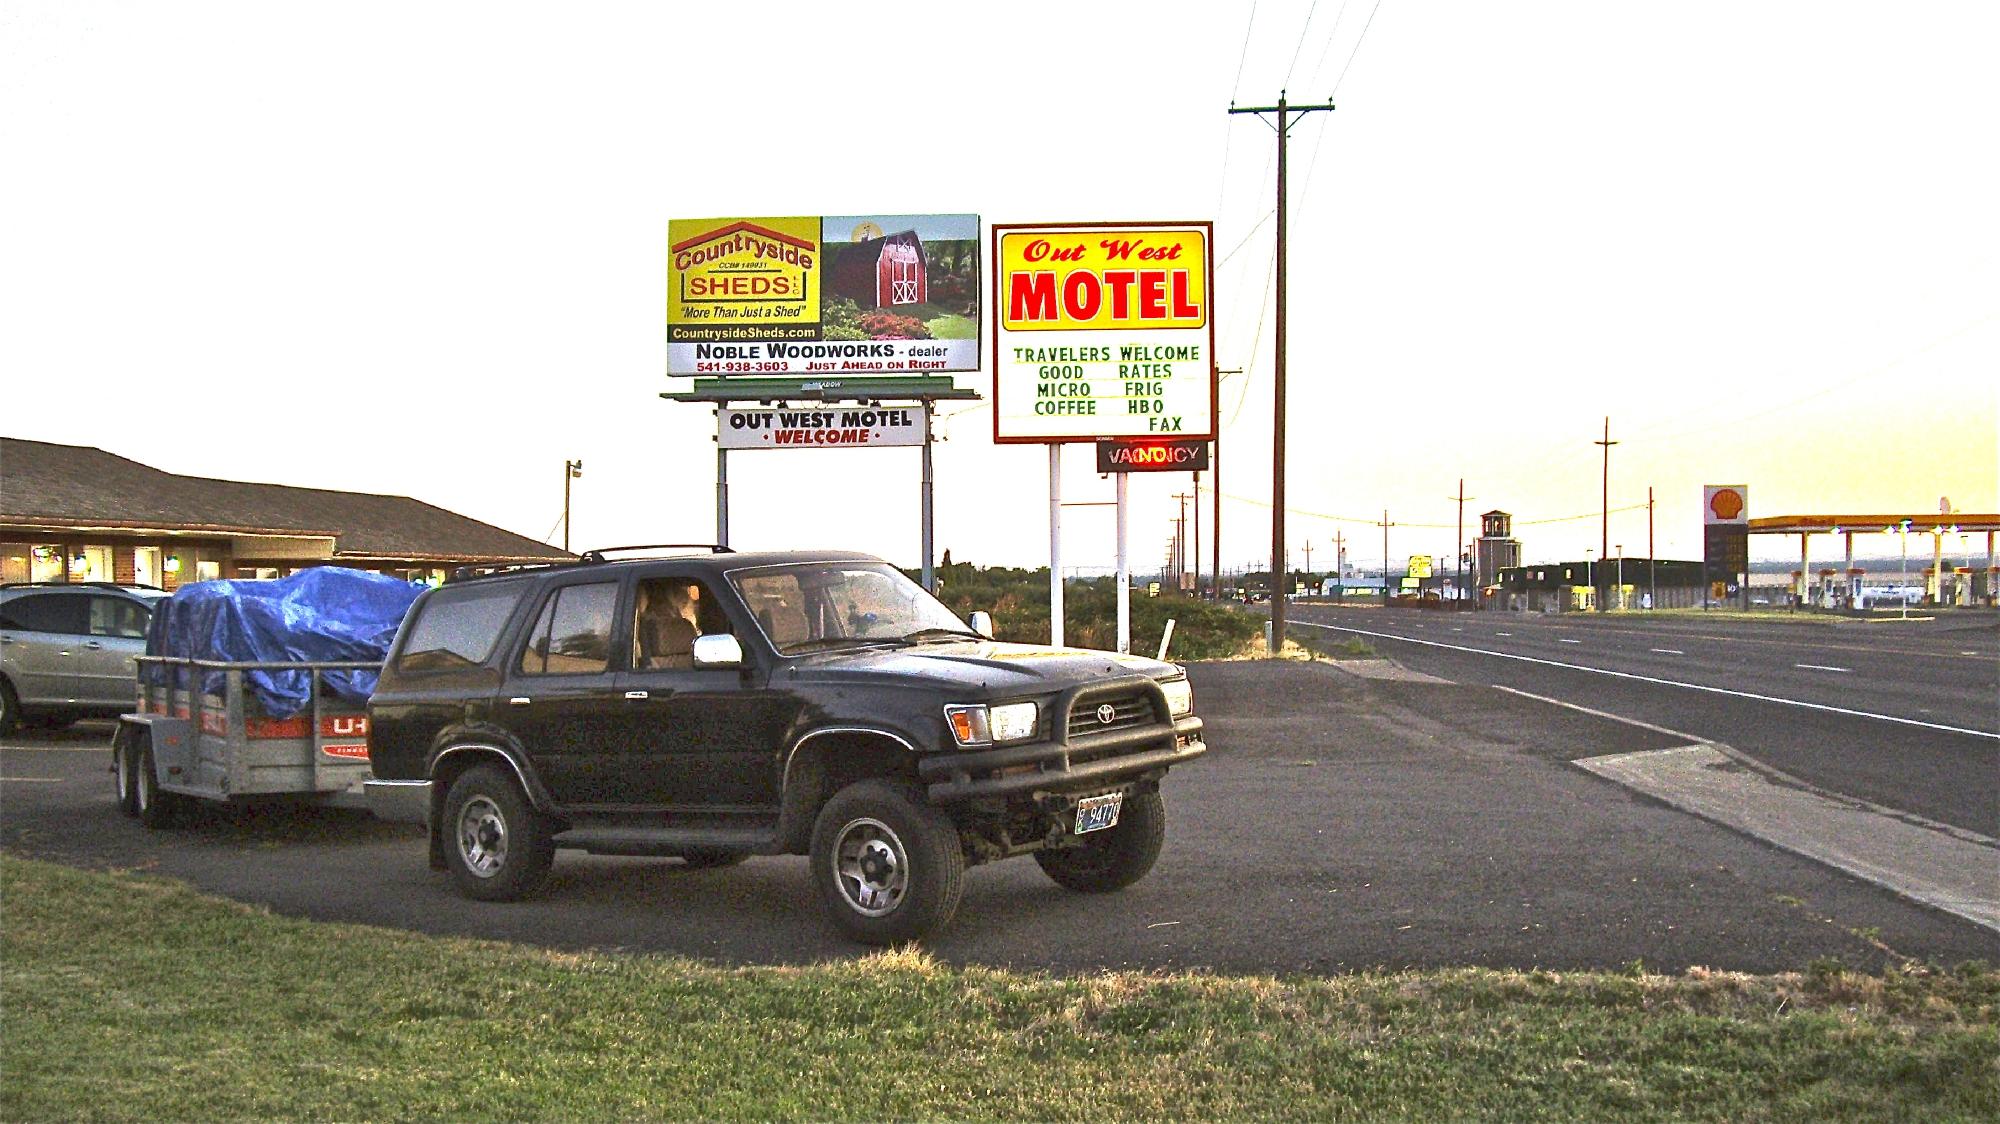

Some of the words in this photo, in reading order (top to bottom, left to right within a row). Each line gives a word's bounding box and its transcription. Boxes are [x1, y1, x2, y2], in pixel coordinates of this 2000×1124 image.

[675, 233, 813, 271] Countryside
[1023, 239, 1087, 262] Out
[1099, 238, 1183, 261] West
[690, 276, 790, 295] SHEDS
[1009, 269, 1200, 321] MOTEL
[713, 306, 738, 318] Than
[740, 306, 763, 318] Just
[765, 309, 771, 317] a
[673, 327, 815, 340] CountrysideSheds.com
[908, 346, 948, 357] dealer
[1014, 346, 1110, 362] TRAVELERS
[1120, 345, 1199, 361] WELCOME
[697, 361, 789, 372] 541-938-3603
[1039, 365, 1083, 380] GOOD
[1119, 364, 1172, 378] RATES
[1037, 382, 1091, 397] MICRO
[1125, 382, 1163, 396] FRIG
[1035, 400, 1096, 415] COFFEE
[1128, 399, 1164, 414] HBO
[729, 413, 774, 430] OUT
[780, 412, 835, 428] WEST
[841, 411, 912, 427] MOTEL
[1149, 416, 1182, 431] FAX
[774, 429, 870, 444] WELCOME
[1138, 447, 1167, 463] NO
